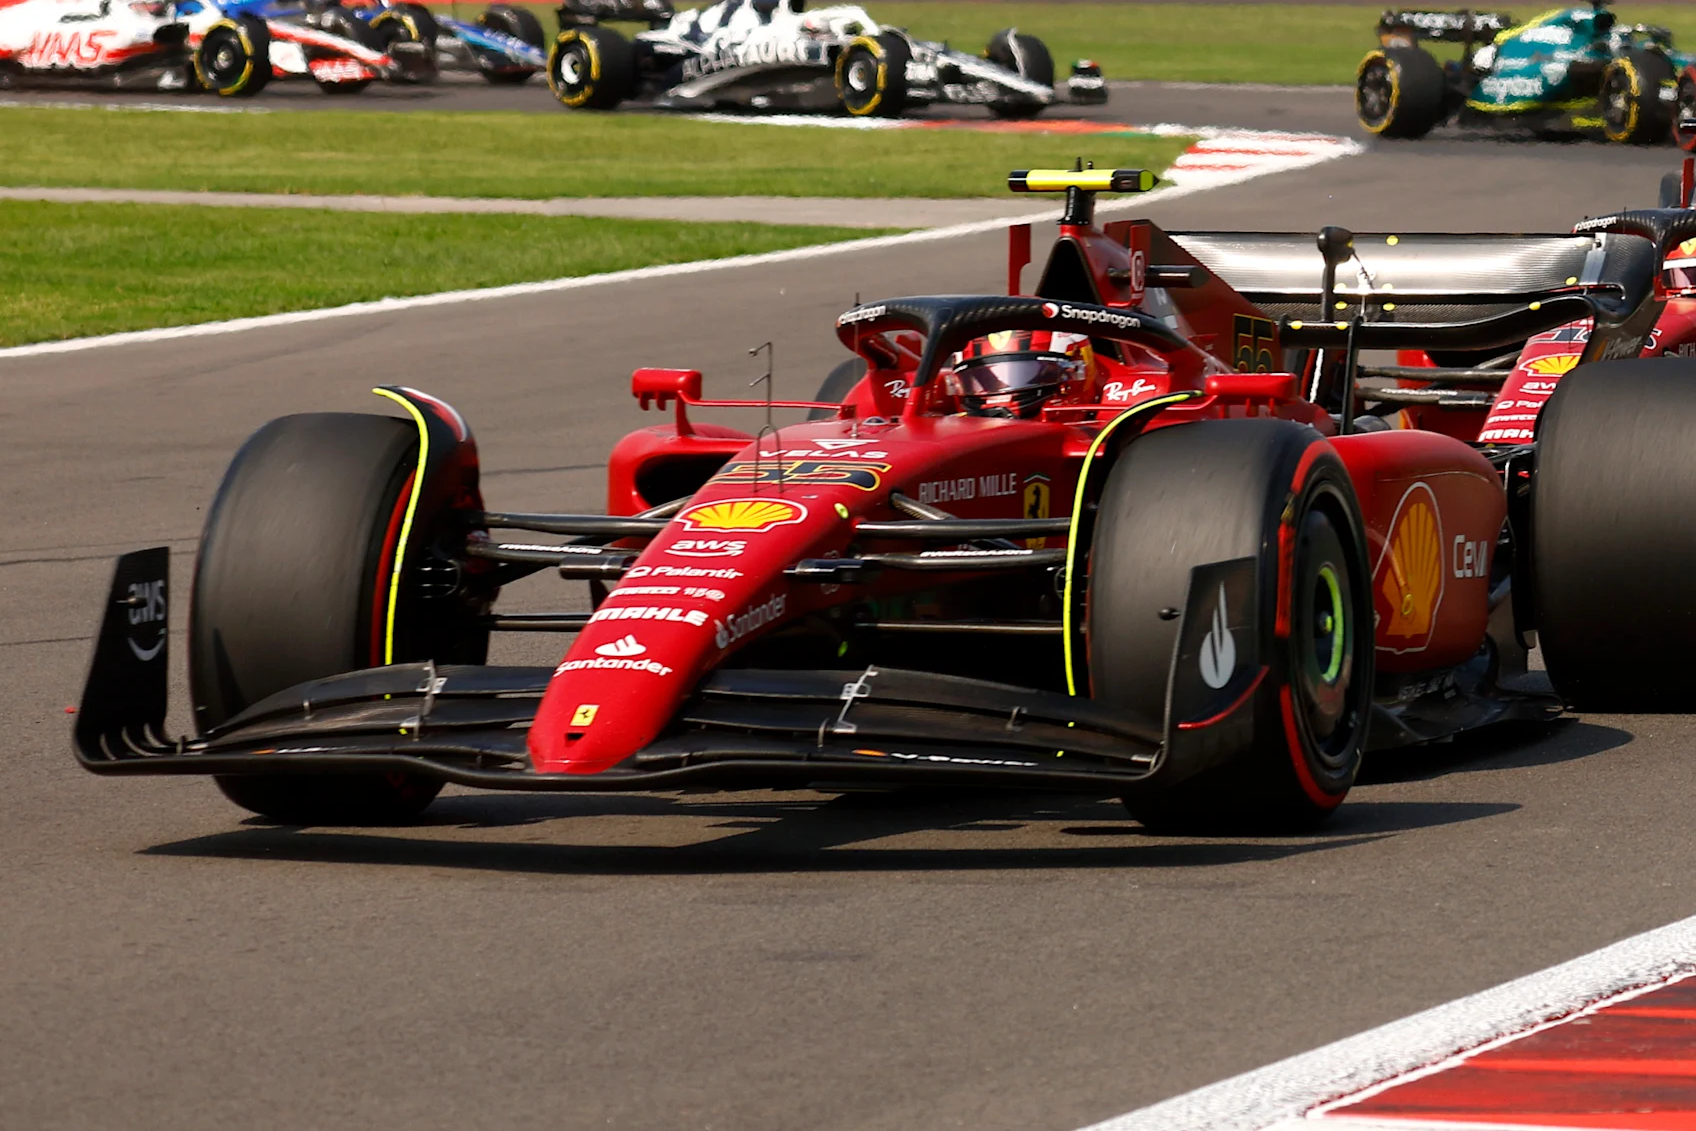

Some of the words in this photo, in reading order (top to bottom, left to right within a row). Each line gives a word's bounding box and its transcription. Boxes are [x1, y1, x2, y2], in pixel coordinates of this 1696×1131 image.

[1061, 304, 1141, 329] Snapdragon
[1523, 381, 1556, 390] aw
[1478, 429, 1534, 442] MAH
[759, 450, 889, 459] VELAS
[706, 460, 893, 492] 55
[918, 476, 976, 504] RICHARD
[979, 472, 1018, 498] MILLE
[670, 539, 748, 553] aws
[652, 566, 744, 580] Palantir
[587, 606, 710, 627] MAHLE
[728, 593, 787, 644] Santander
